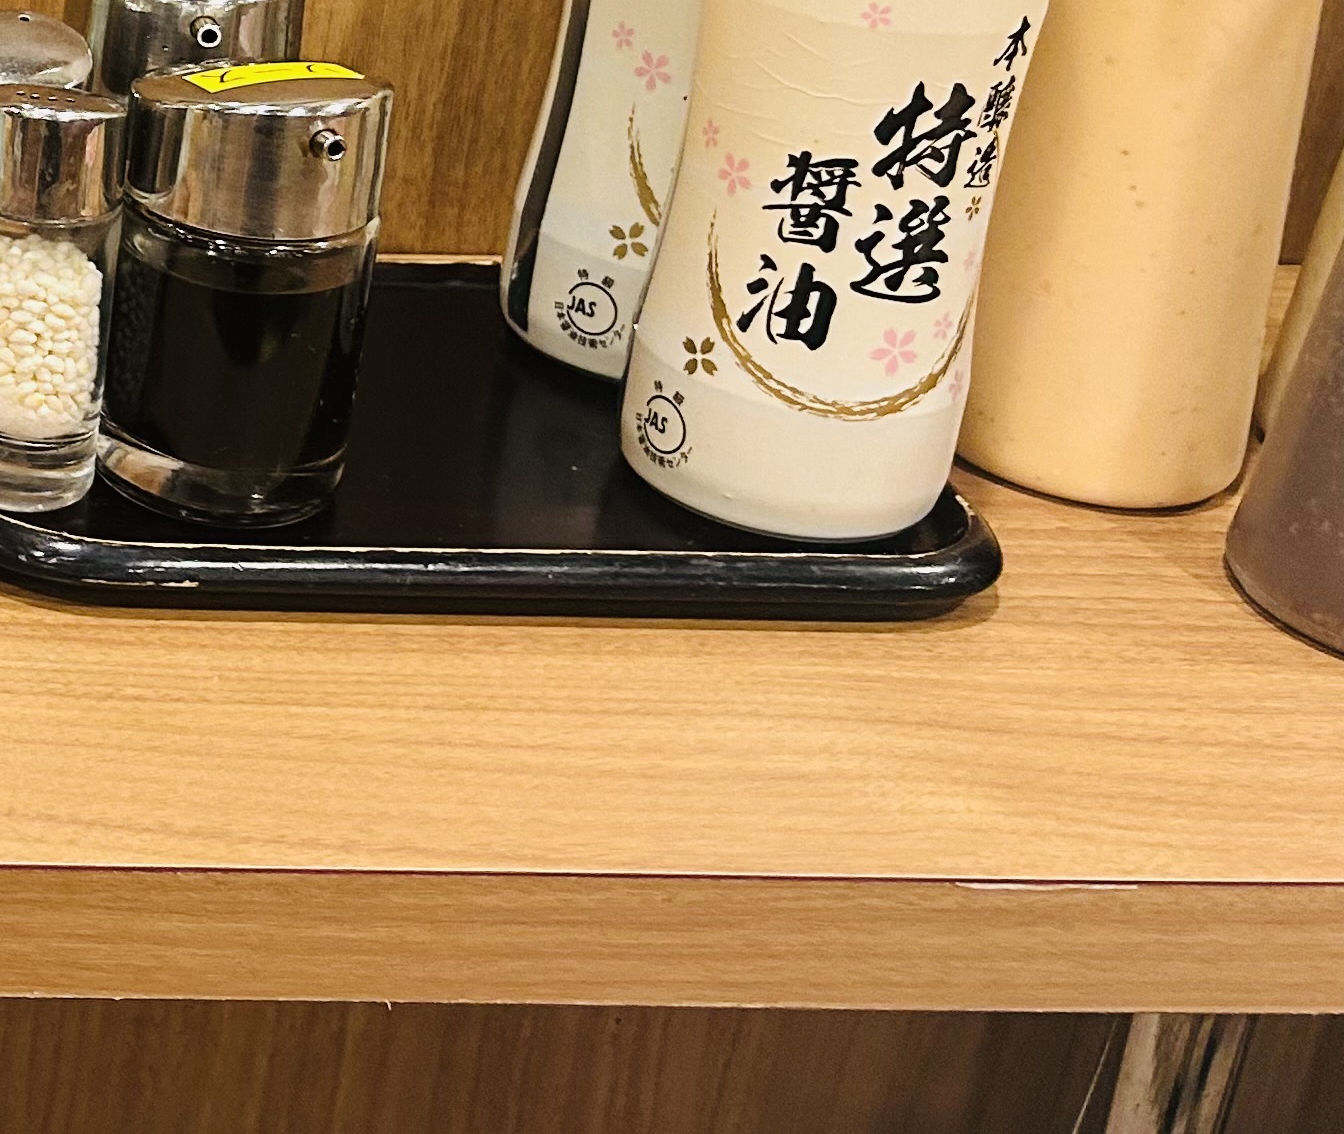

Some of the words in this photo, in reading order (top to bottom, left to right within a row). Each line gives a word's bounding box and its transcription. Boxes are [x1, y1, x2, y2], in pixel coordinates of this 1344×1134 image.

[849, 80, 978, 304] 特選
[566, 295, 597, 318] JAS
[644, 407, 668, 434] JAS
